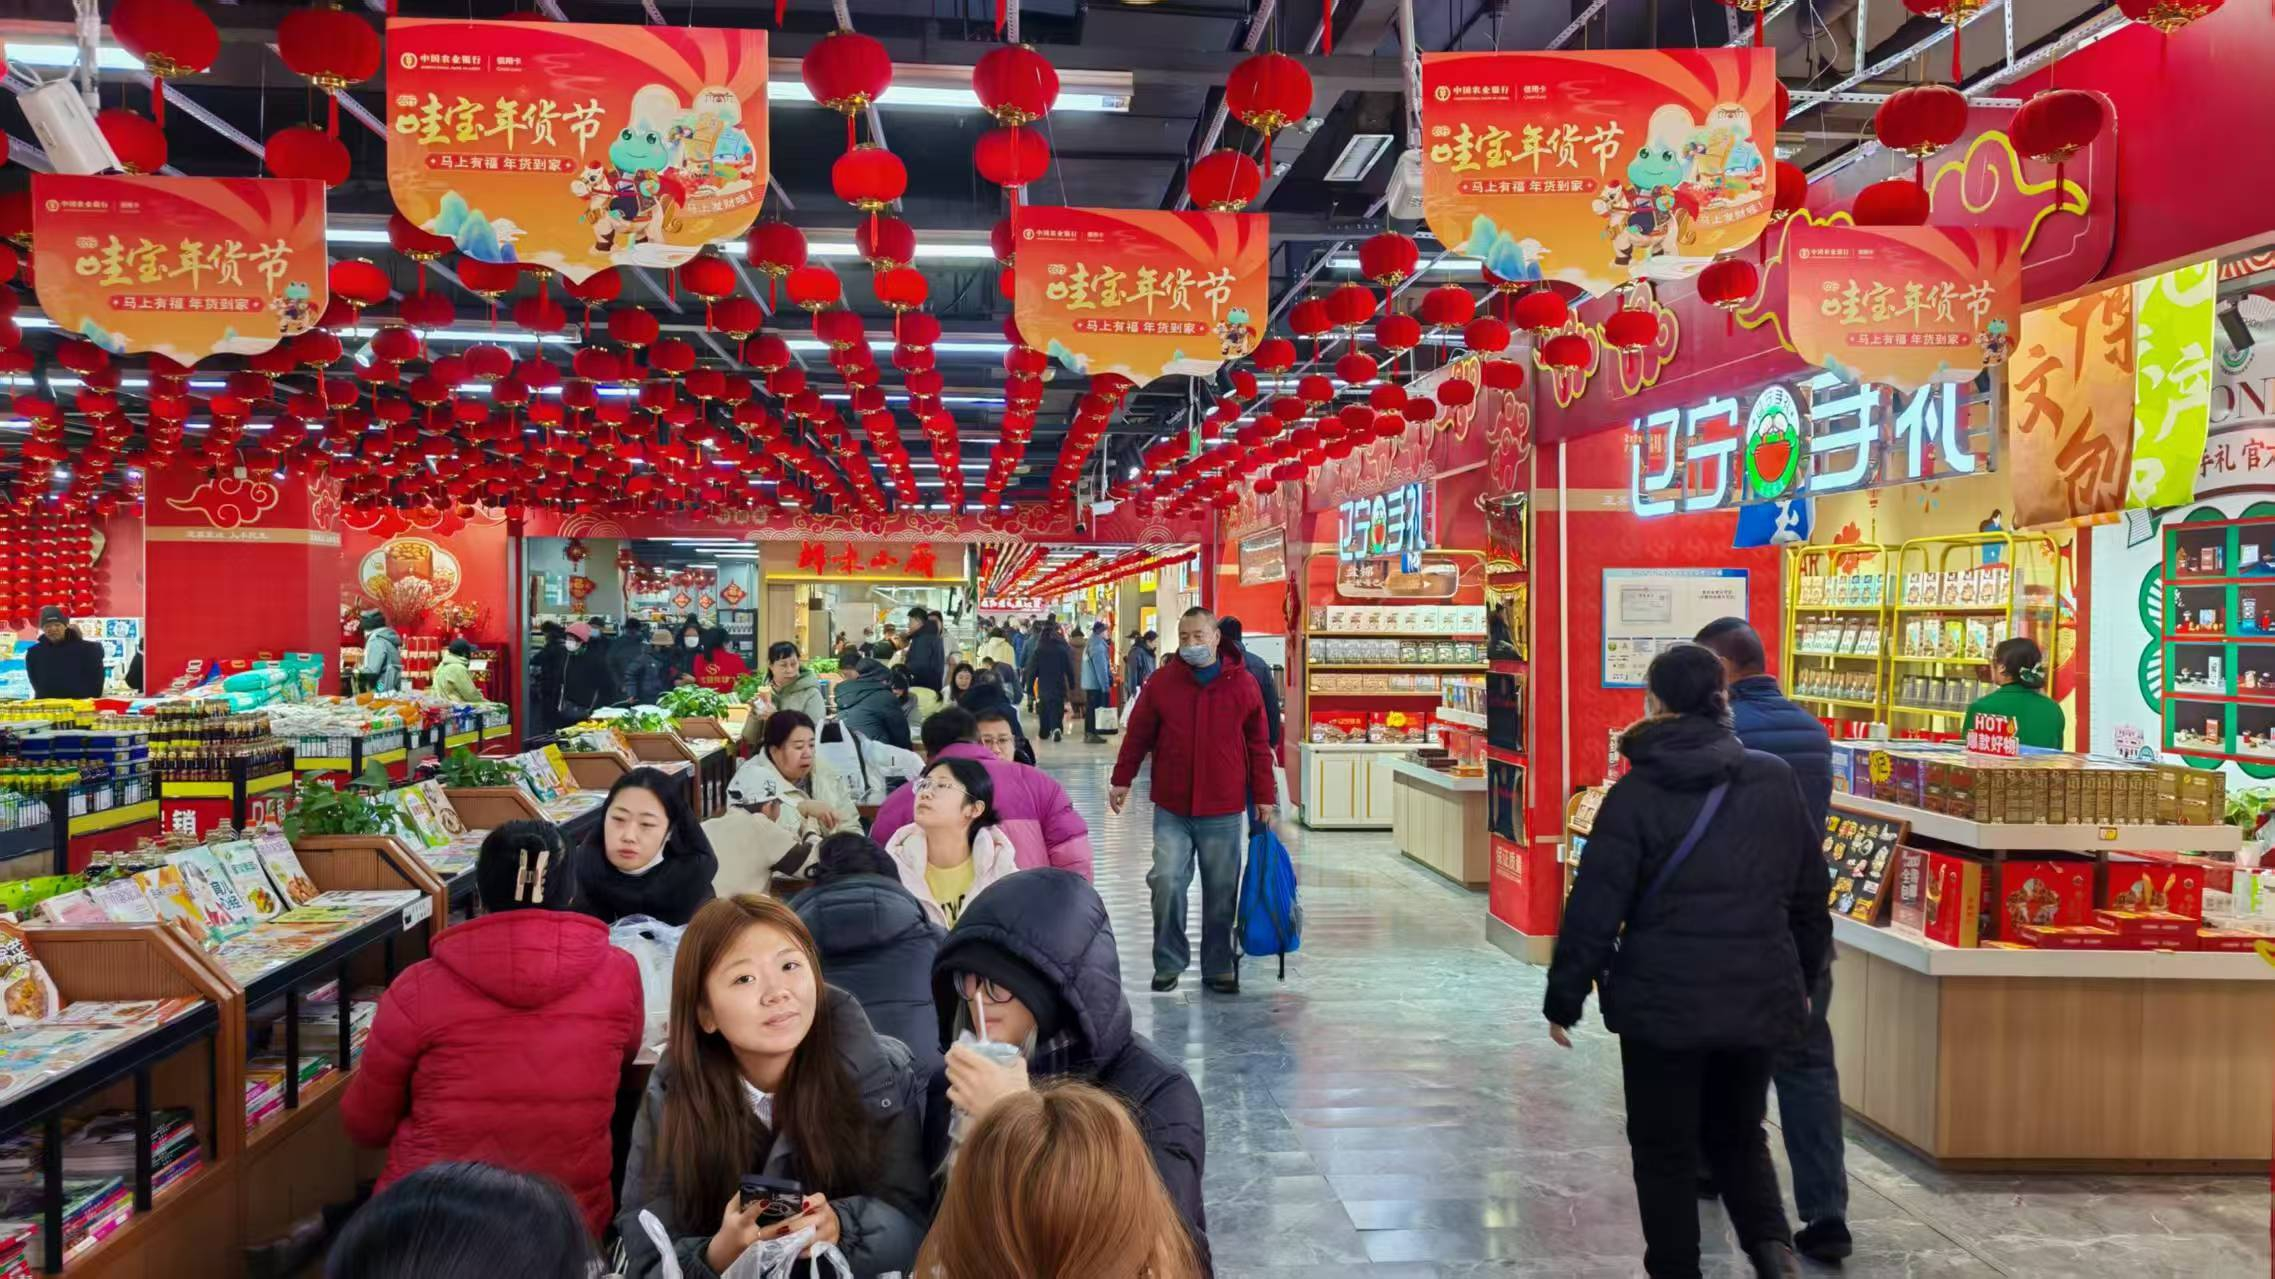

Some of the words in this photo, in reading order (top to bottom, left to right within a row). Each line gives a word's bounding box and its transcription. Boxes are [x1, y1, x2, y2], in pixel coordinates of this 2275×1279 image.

[420, 54, 481, 65] 中国农业银行
[1453, 85, 1509, 94] 中国农业银行
[395, 92, 606, 161] 哇宝年货节
[1430, 120, 1624, 176] 哇宝年货节
[441, 156, 498, 169] 马上有福
[504, 157, 562, 171] 年货到家
[1472, 181, 1525, 193] 马上有福
[1529, 180, 1584, 192] 年货到家
[75, 234, 293, 295] 哇宝年货节
[1046, 262, 1236, 321] 哇宝年货节
[123, 297, 184, 310] 马上有福
[189, 297, 249, 311] 年货到家
[1820, 279, 1997, 330] 哇宝年货节
[1086, 320, 1139, 332] 马上有福
[1143, 321, 1196, 334] 年货到家
[1858, 334, 1907, 345] 马上有福
[1911, 334, 1960, 345] 年货到家
[1975, 714, 2004, 733] HOT
